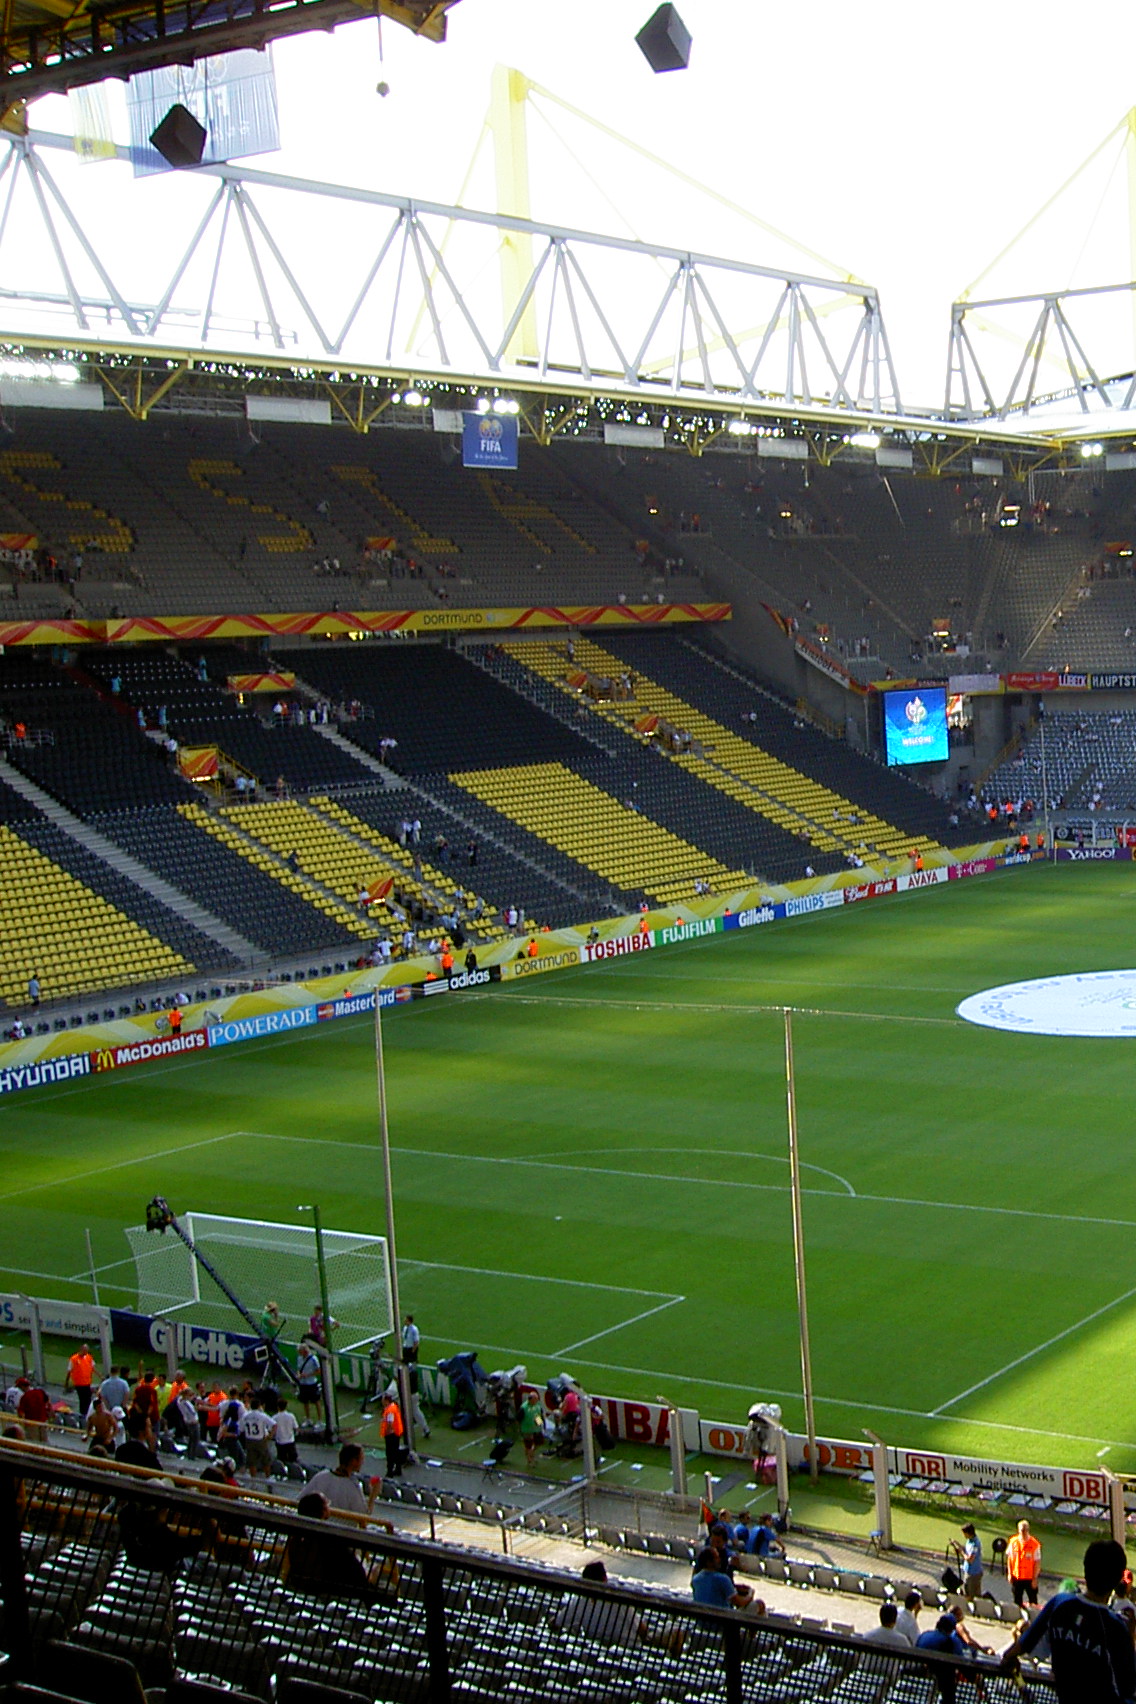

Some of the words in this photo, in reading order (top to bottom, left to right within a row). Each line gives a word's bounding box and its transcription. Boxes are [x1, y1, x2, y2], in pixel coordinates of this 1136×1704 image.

[480, 440, 501, 452] FIFA
[423, 613, 483, 625] DORTMUND
[1067, 849, 1116, 861] YAHOO!
[909, 871, 938, 888] AVAYA
[788, 896, 825, 913] PHILIPS
[738, 907, 775, 927] Gillette
[662, 919, 716, 944] FUJIFILM
[585, 931, 651, 960] TOSHIBA
[514, 950, 578, 975] DORTMUND
[450, 966, 490, 990] adidas
[335, 990, 395, 1016] MasterCard
[211, 1006, 316, 1041] POWERADE
[116, 1033, 206, 1066] McDonald's
[0, 1056, 90, 1093] HYUNDAI
[64, 1320, 101, 1335] simplici
[149, 1318, 245, 1370] Gllette
[244, 1422, 259, 1436] 13
[911, 1457, 942, 1477] DB
[953, 1460, 999, 1477] Mobility
[1001, 1463, 1055, 1482] Networks
[980, 1476, 1029, 1491] Logistics
[1069, 1475, 1101, 1500] DB
[1053, 1627, 1102, 1655] ITALIA
